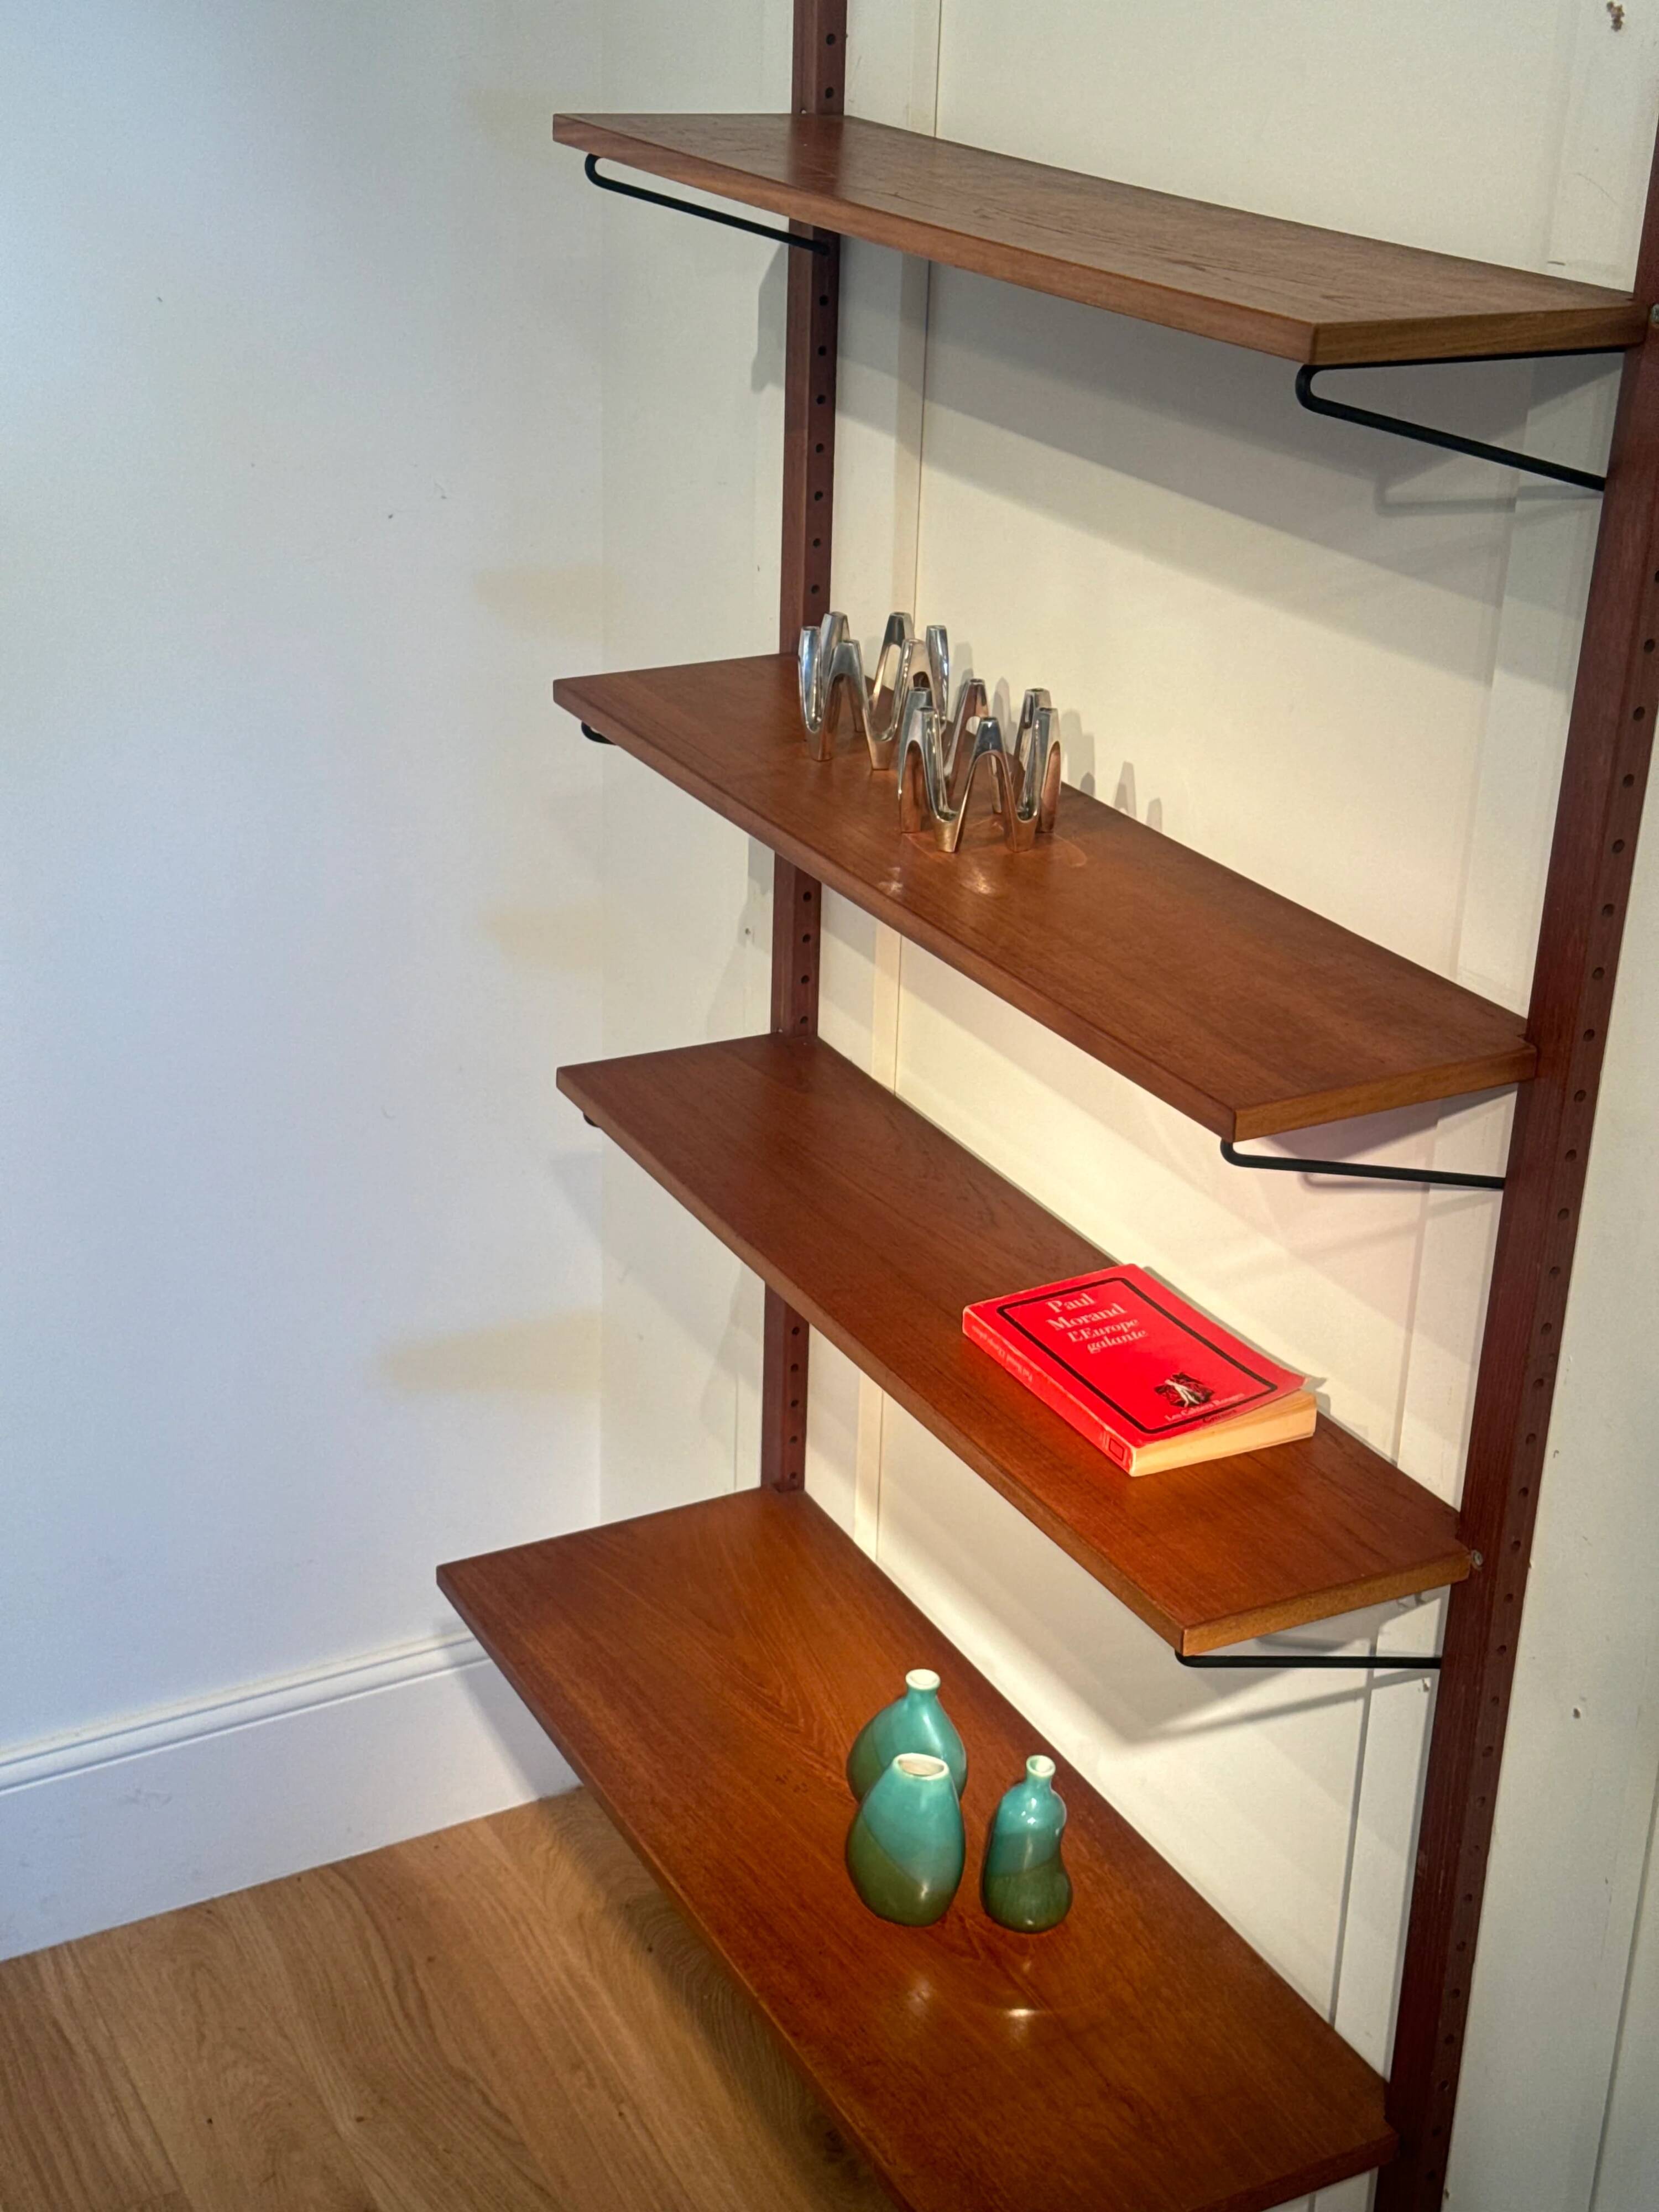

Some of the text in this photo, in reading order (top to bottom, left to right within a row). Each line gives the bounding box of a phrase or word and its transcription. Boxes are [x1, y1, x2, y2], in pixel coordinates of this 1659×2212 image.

[1045, 1292, 1095, 1313] Paul
[1045, 1302, 1128, 1331] Morand
[1067, 1319, 1139, 1343] L'Europe
[1087, 1330, 1148, 1354] galante
